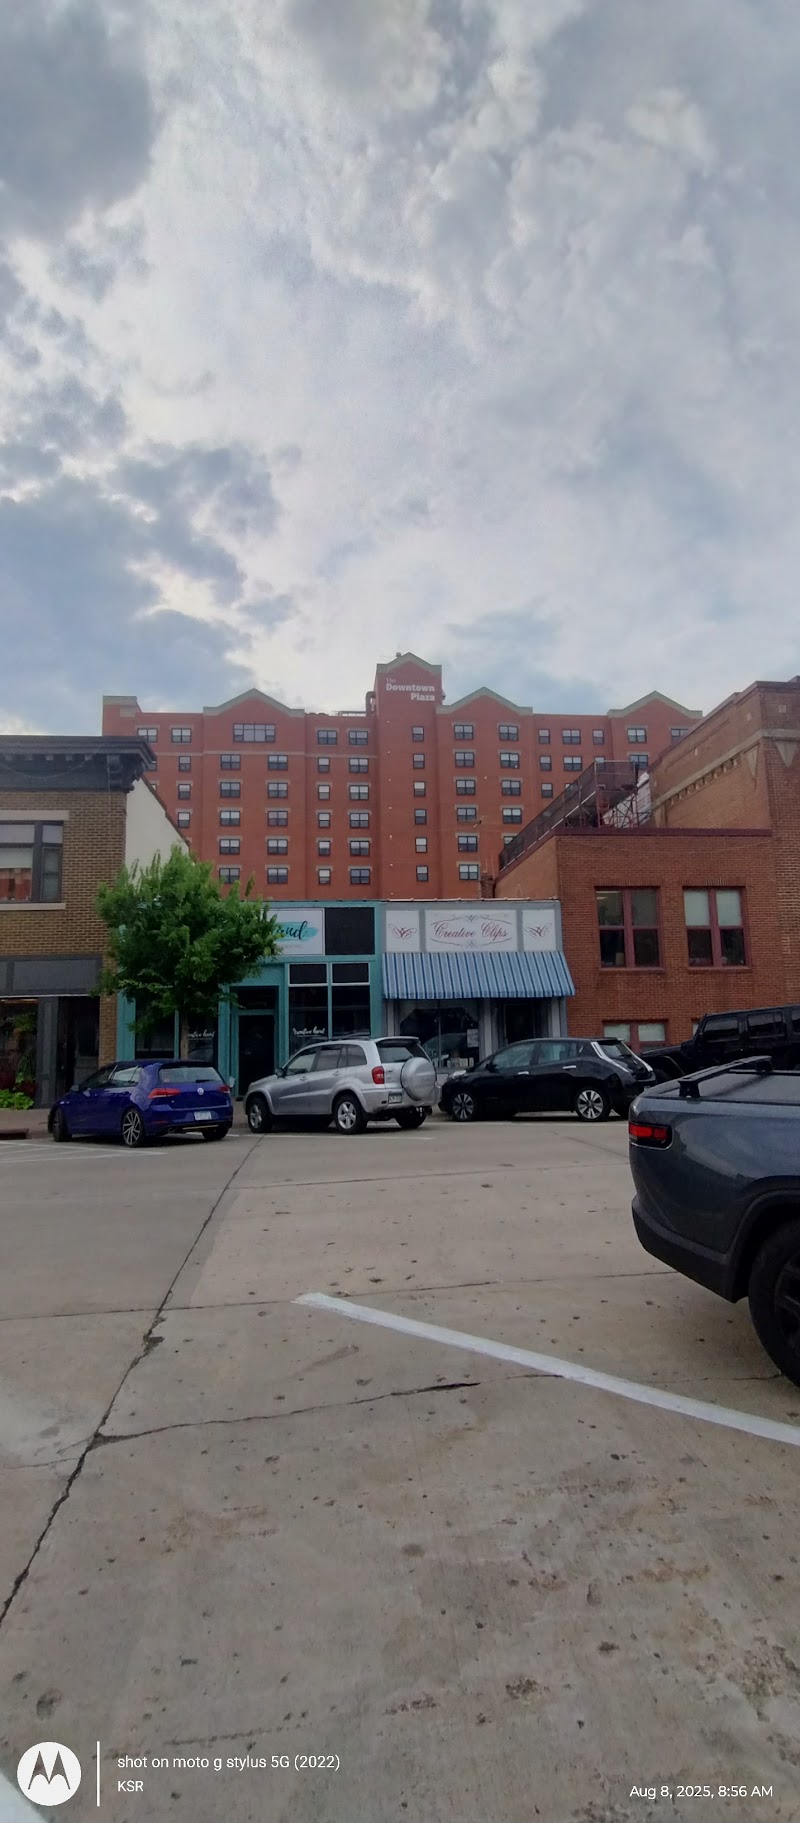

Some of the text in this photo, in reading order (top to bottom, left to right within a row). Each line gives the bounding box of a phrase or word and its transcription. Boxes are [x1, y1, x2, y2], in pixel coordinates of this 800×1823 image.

[386, 683, 435, 692] Downtown
[410, 692, 435, 701] Plaza
[433, 921, 508, 941] Creative Clips
